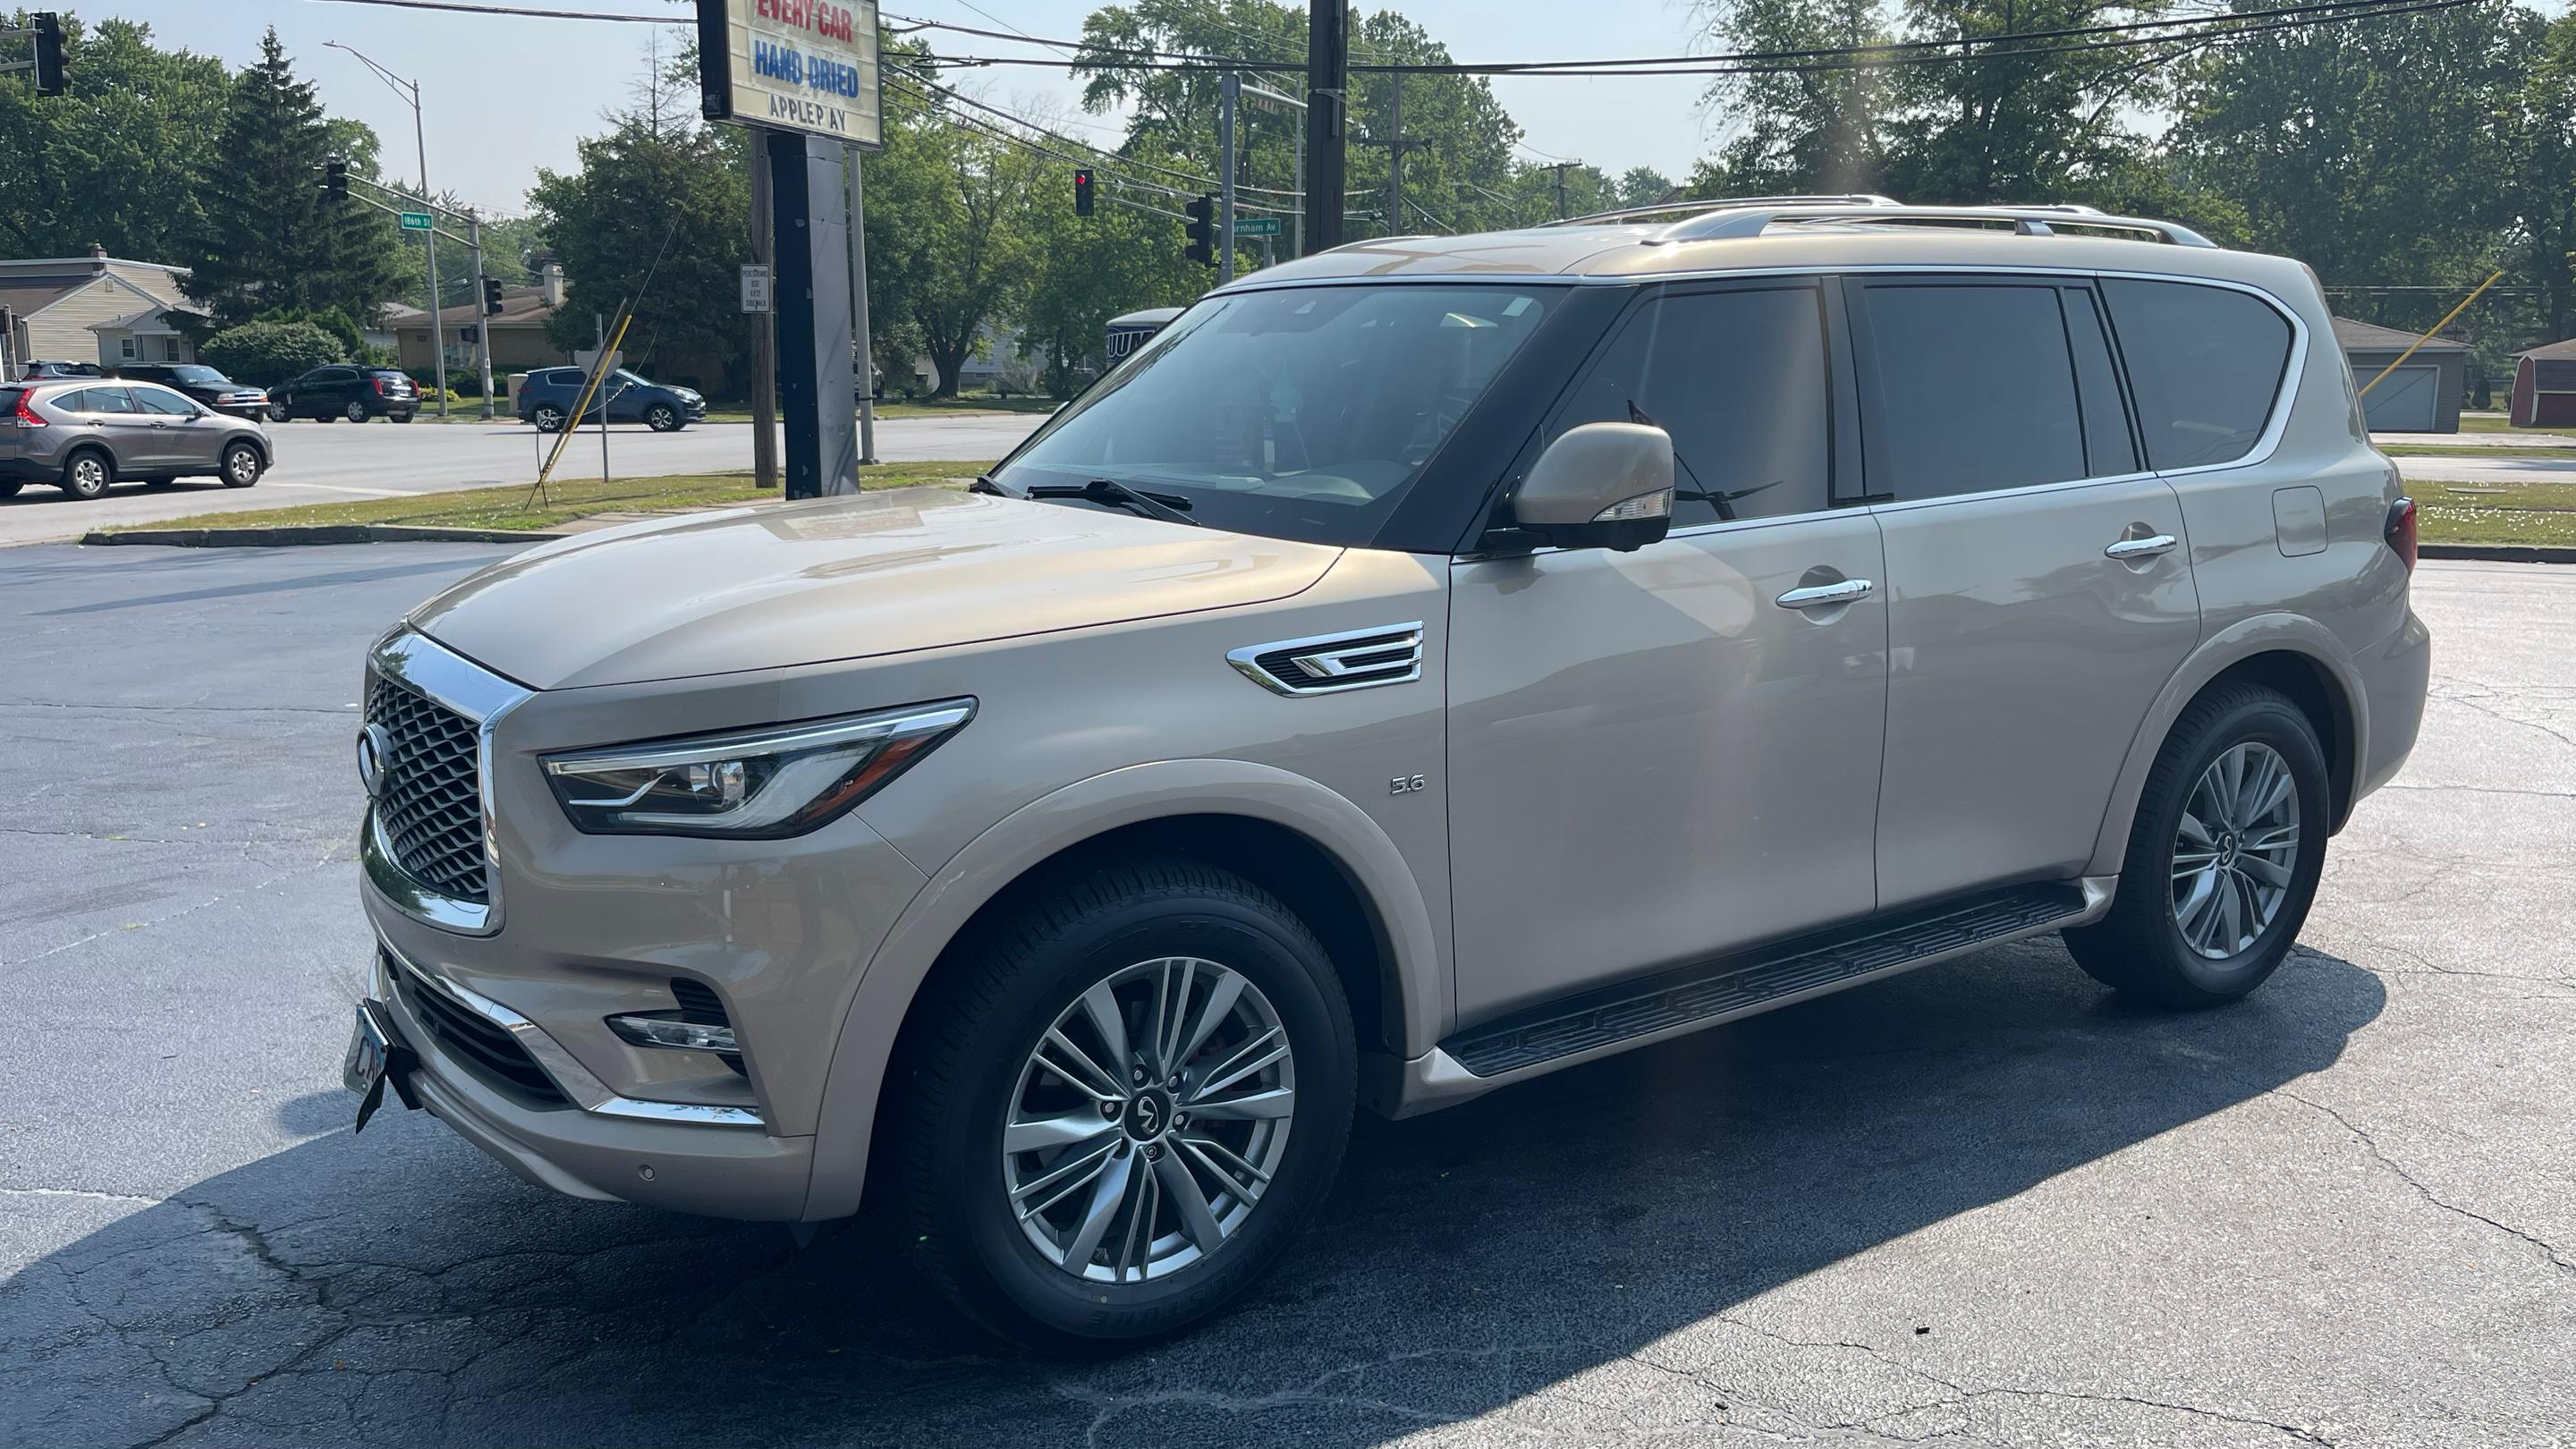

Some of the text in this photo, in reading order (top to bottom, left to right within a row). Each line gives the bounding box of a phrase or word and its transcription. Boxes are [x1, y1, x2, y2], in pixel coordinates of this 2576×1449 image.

[818, 2, 852, 43] CAR
[754, 40, 859, 98] HAND DRIED
[404, 216, 431, 227] 186th St
[1266, 223, 1276, 232] Av
[1391, 774, 1425, 795] 5.6
